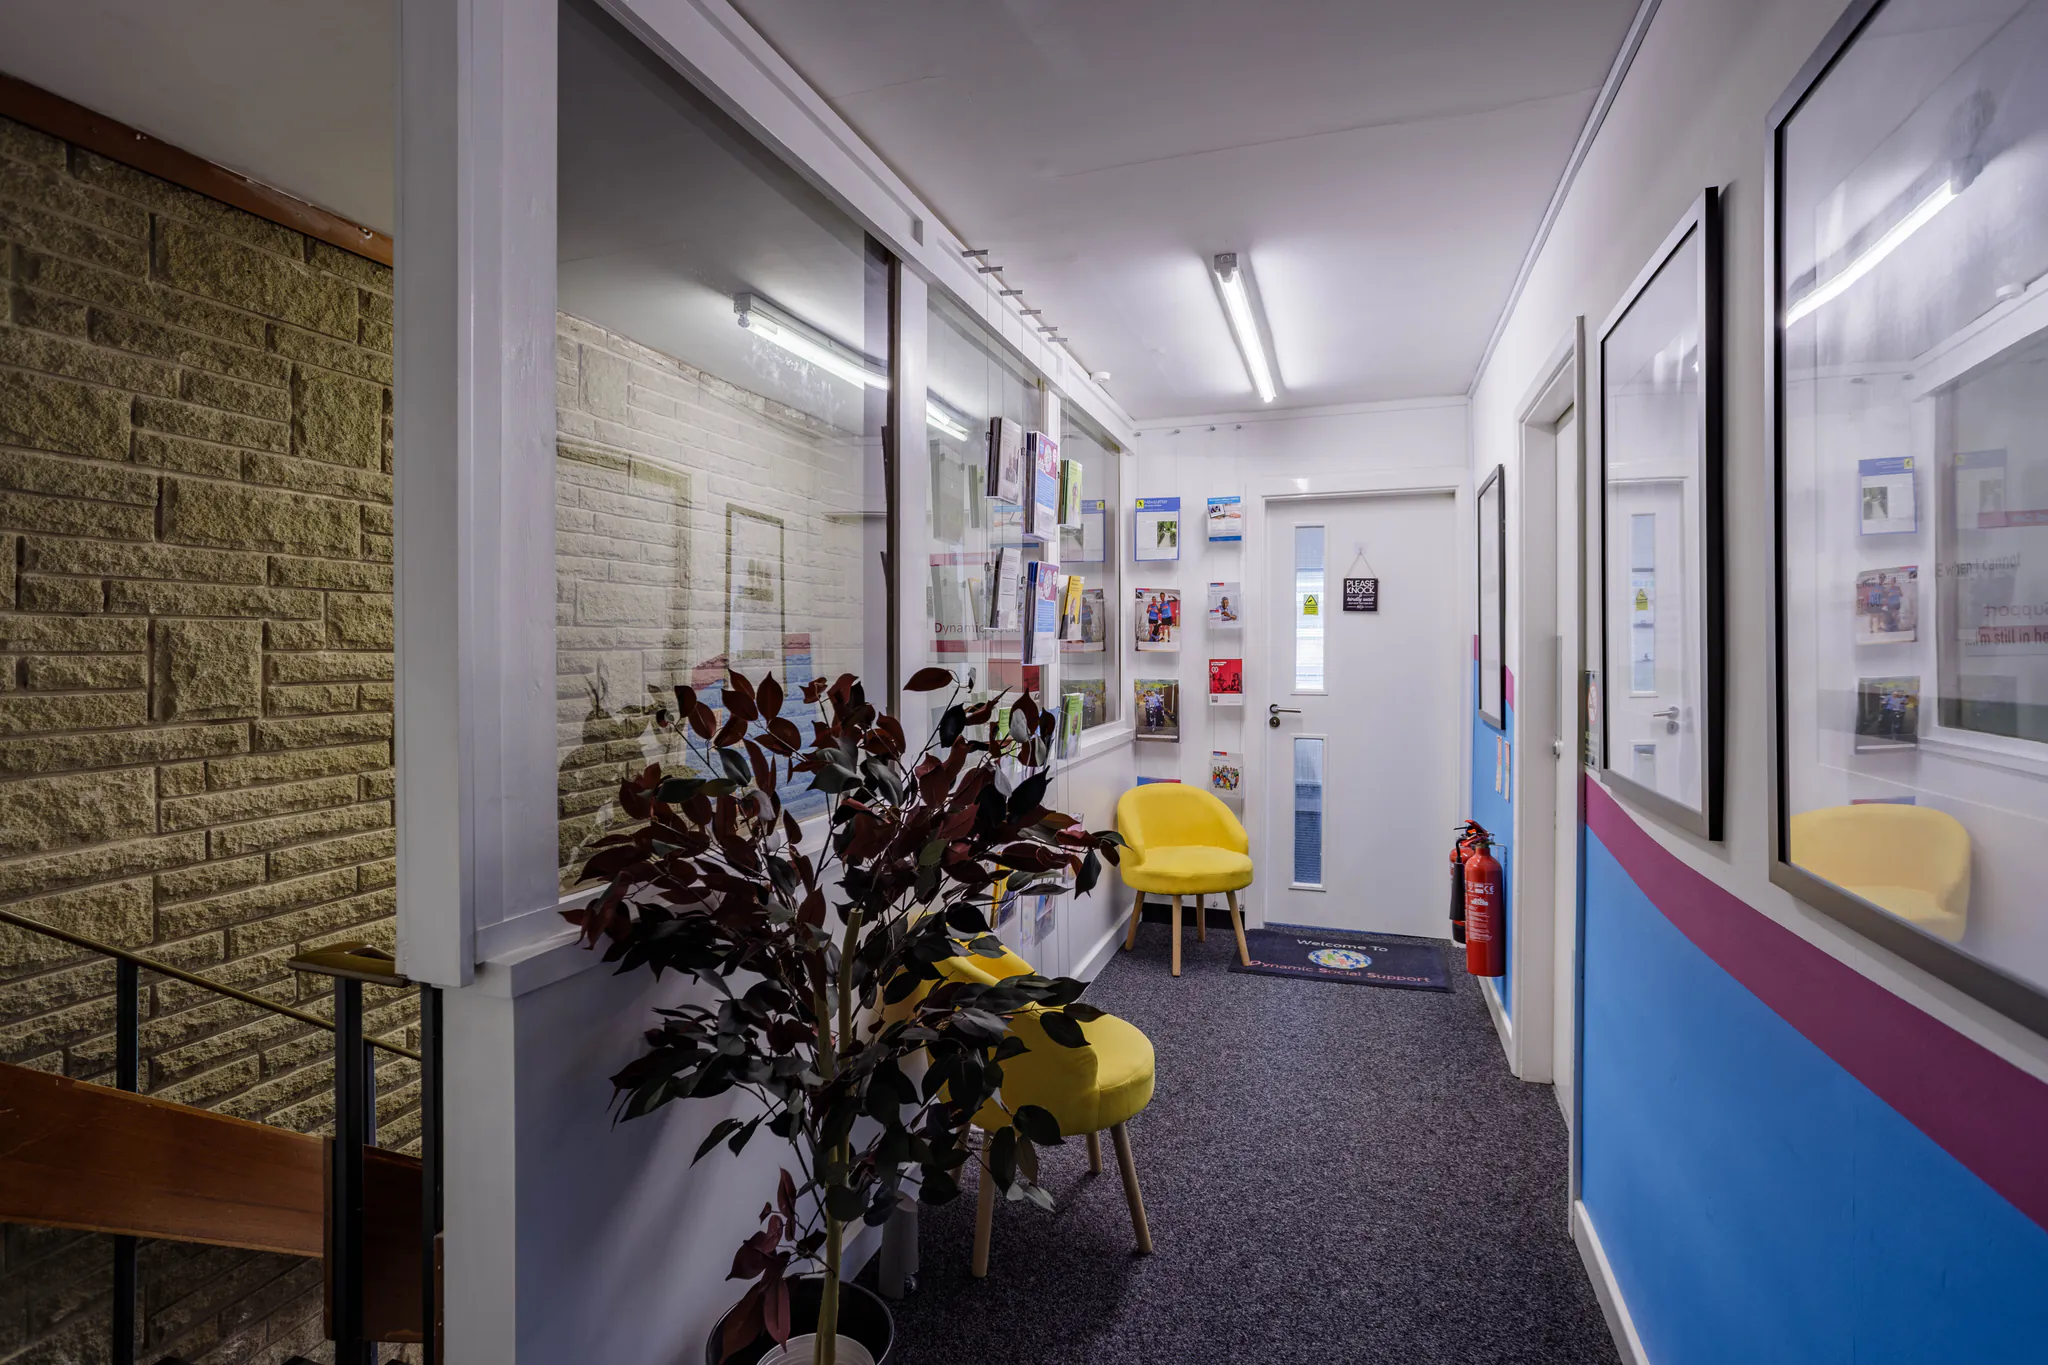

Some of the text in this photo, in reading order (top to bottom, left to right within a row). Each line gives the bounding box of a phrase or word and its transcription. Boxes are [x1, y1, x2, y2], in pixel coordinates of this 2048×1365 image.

[934, 622, 985, 635] Dynamic
[1994, 628, 2015, 644] still
[2019, 628, 2030, 643] in
[1297, 939, 1367, 951] Welcome
[1249, 960, 1431, 983] Dynamic Social Support
